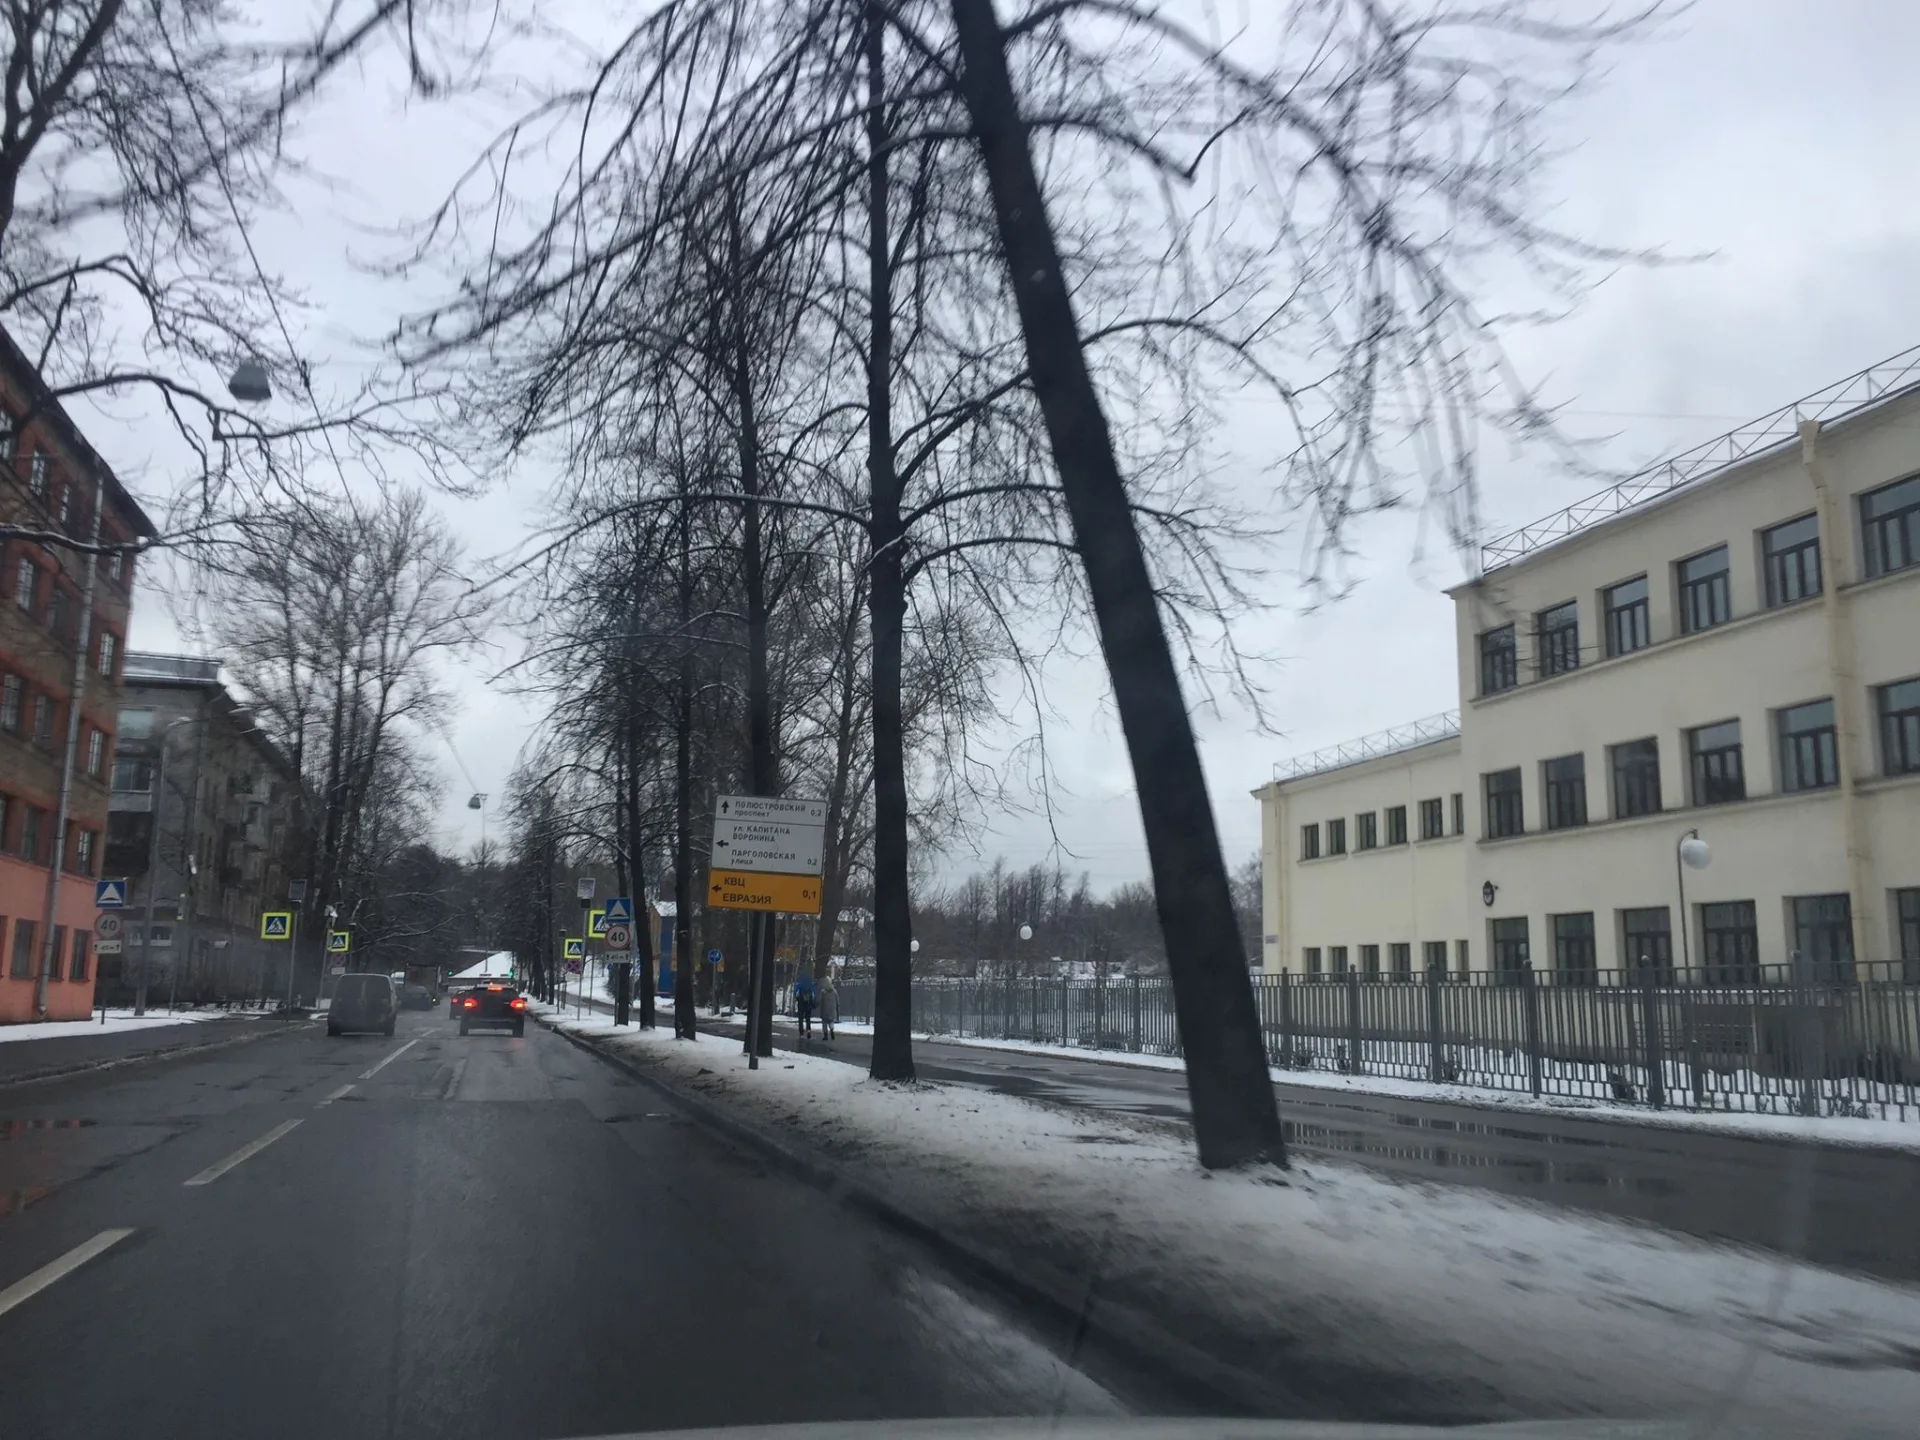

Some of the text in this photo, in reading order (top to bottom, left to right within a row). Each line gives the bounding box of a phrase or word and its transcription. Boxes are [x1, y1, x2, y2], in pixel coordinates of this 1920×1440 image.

[735, 801, 806, 812] ПОЛЮСТРОВСКИЙ
[746, 825, 791, 835] КАПИТАНА
[732, 833, 776, 842] ВОРОНИНА
[731, 849, 796, 860] ПАРГОЛОВСКАЯ
[724, 877, 745, 887] КВЦ
[723, 893, 771, 904] ЕВРАЗИЯ
[802, 889, 817, 900] 0,1
[100, 919, 117, 931] 40
[611, 931, 625, 942] 40
